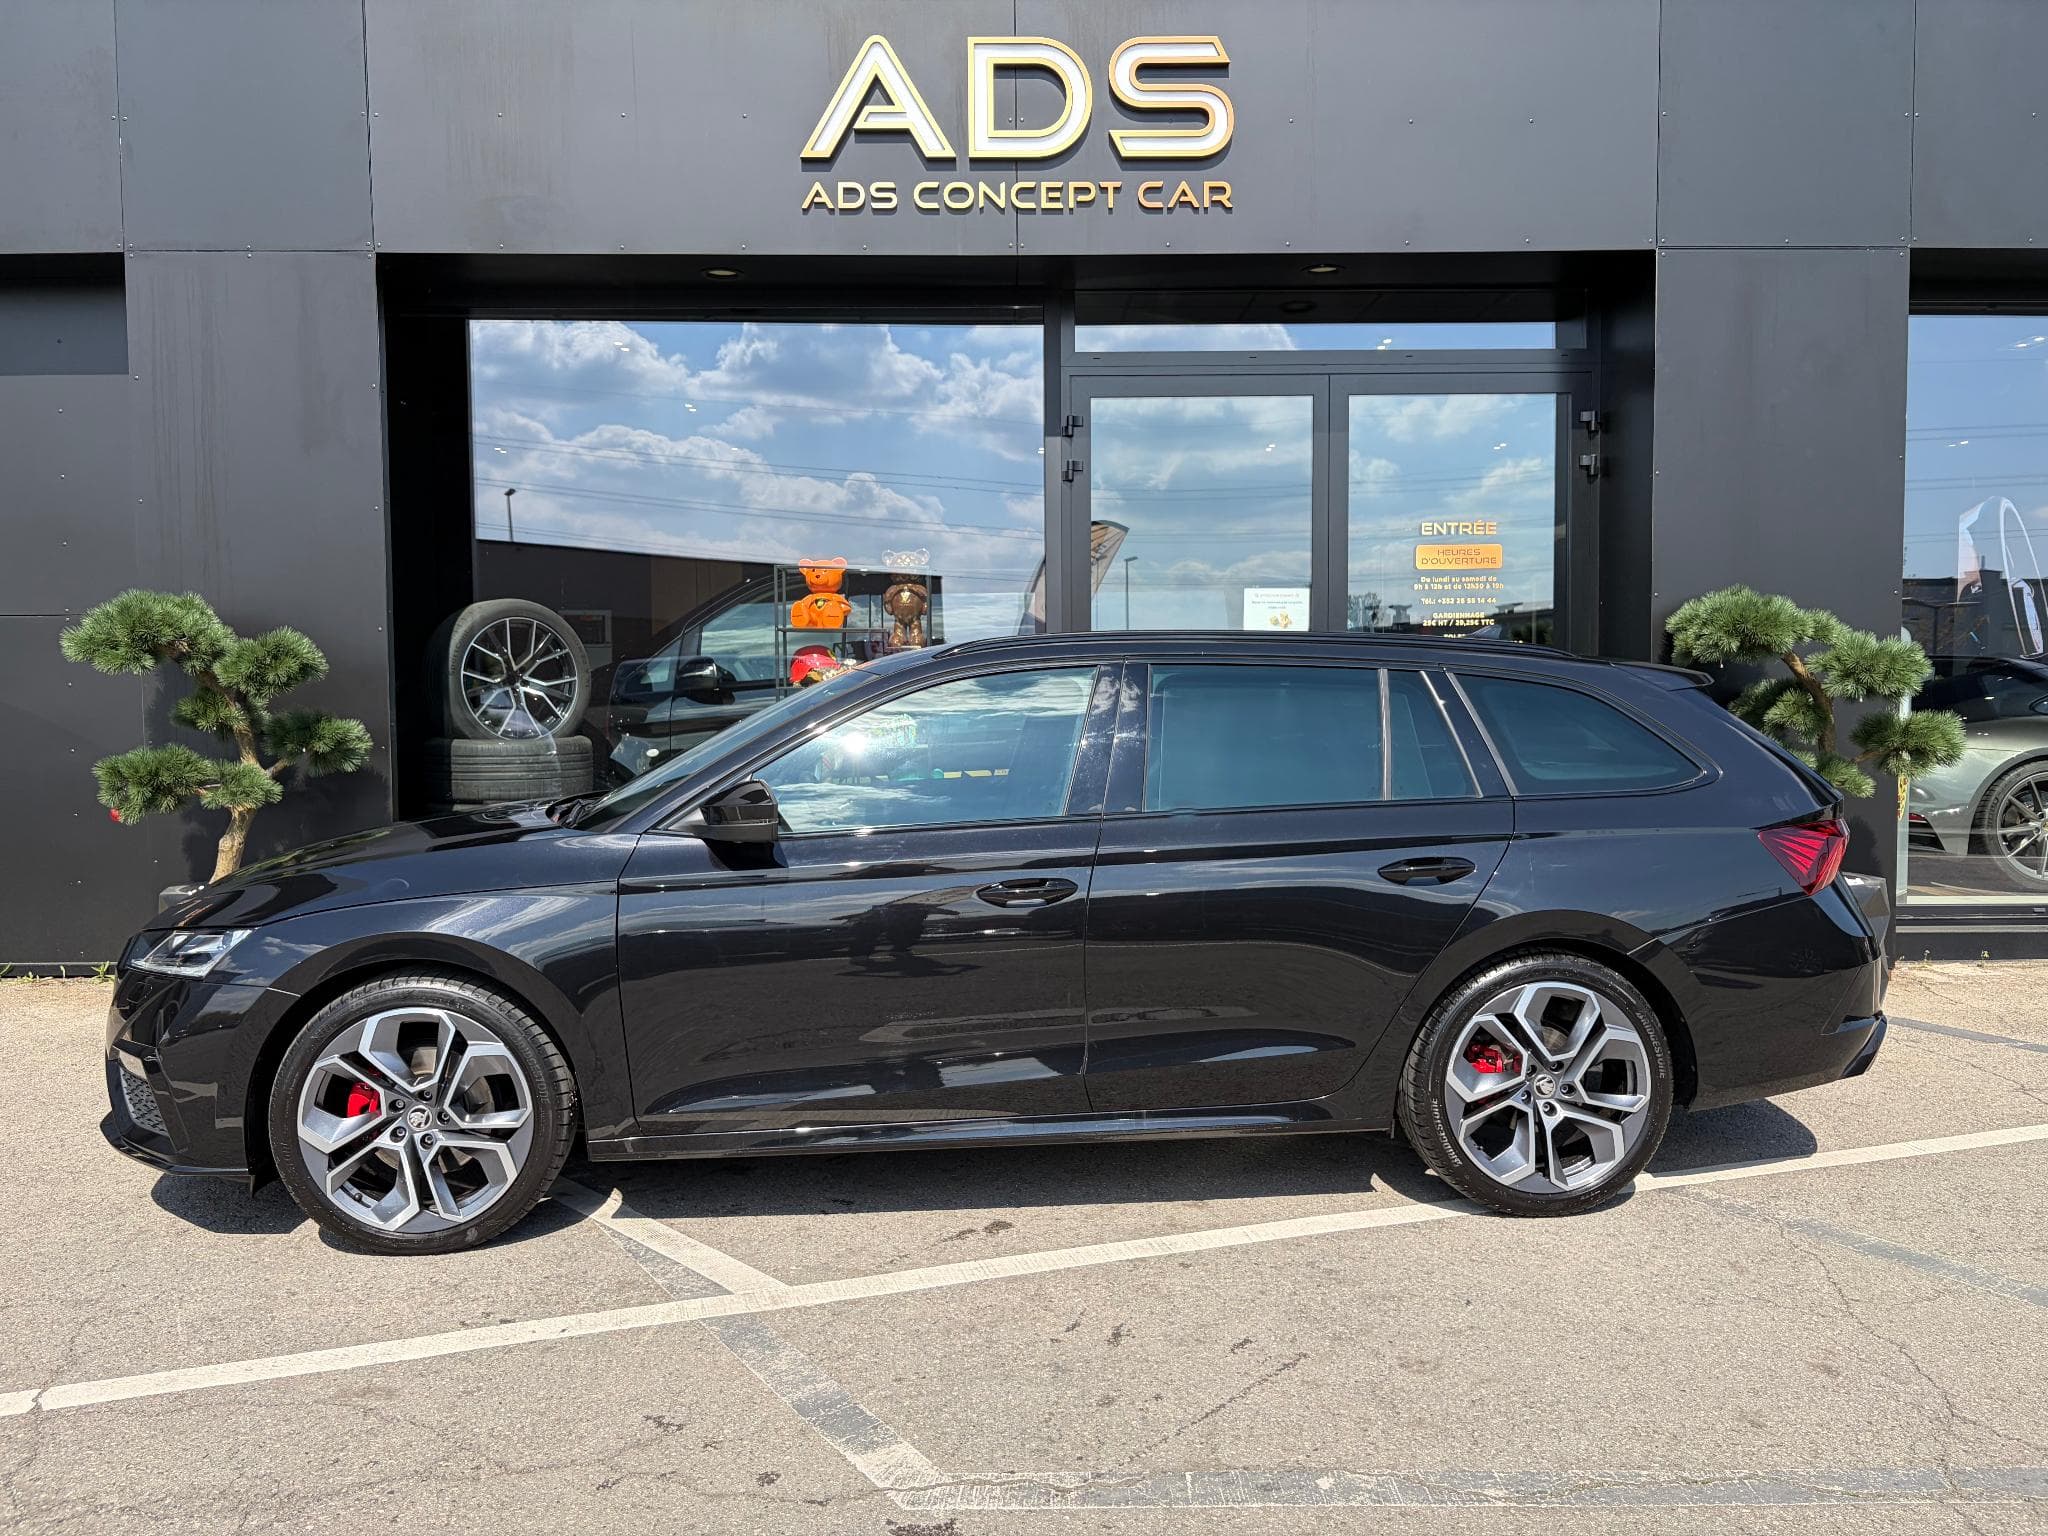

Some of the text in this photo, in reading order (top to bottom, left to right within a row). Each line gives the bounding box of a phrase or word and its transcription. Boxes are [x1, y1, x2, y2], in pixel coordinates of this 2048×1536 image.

[800, 34, 1235, 159] ADS
[801, 181, 1233, 209] ADS CONCEPT CAR
[1421, 519, 1497, 535] ENTRÉE
[1437, 548, 1481, 556] HEURES
[1421, 557, 1497, 565] D'OUVERTURE
[1432, 611, 1485, 619] GARDIENNAGE
[1481, 618, 1495, 626] TTC
